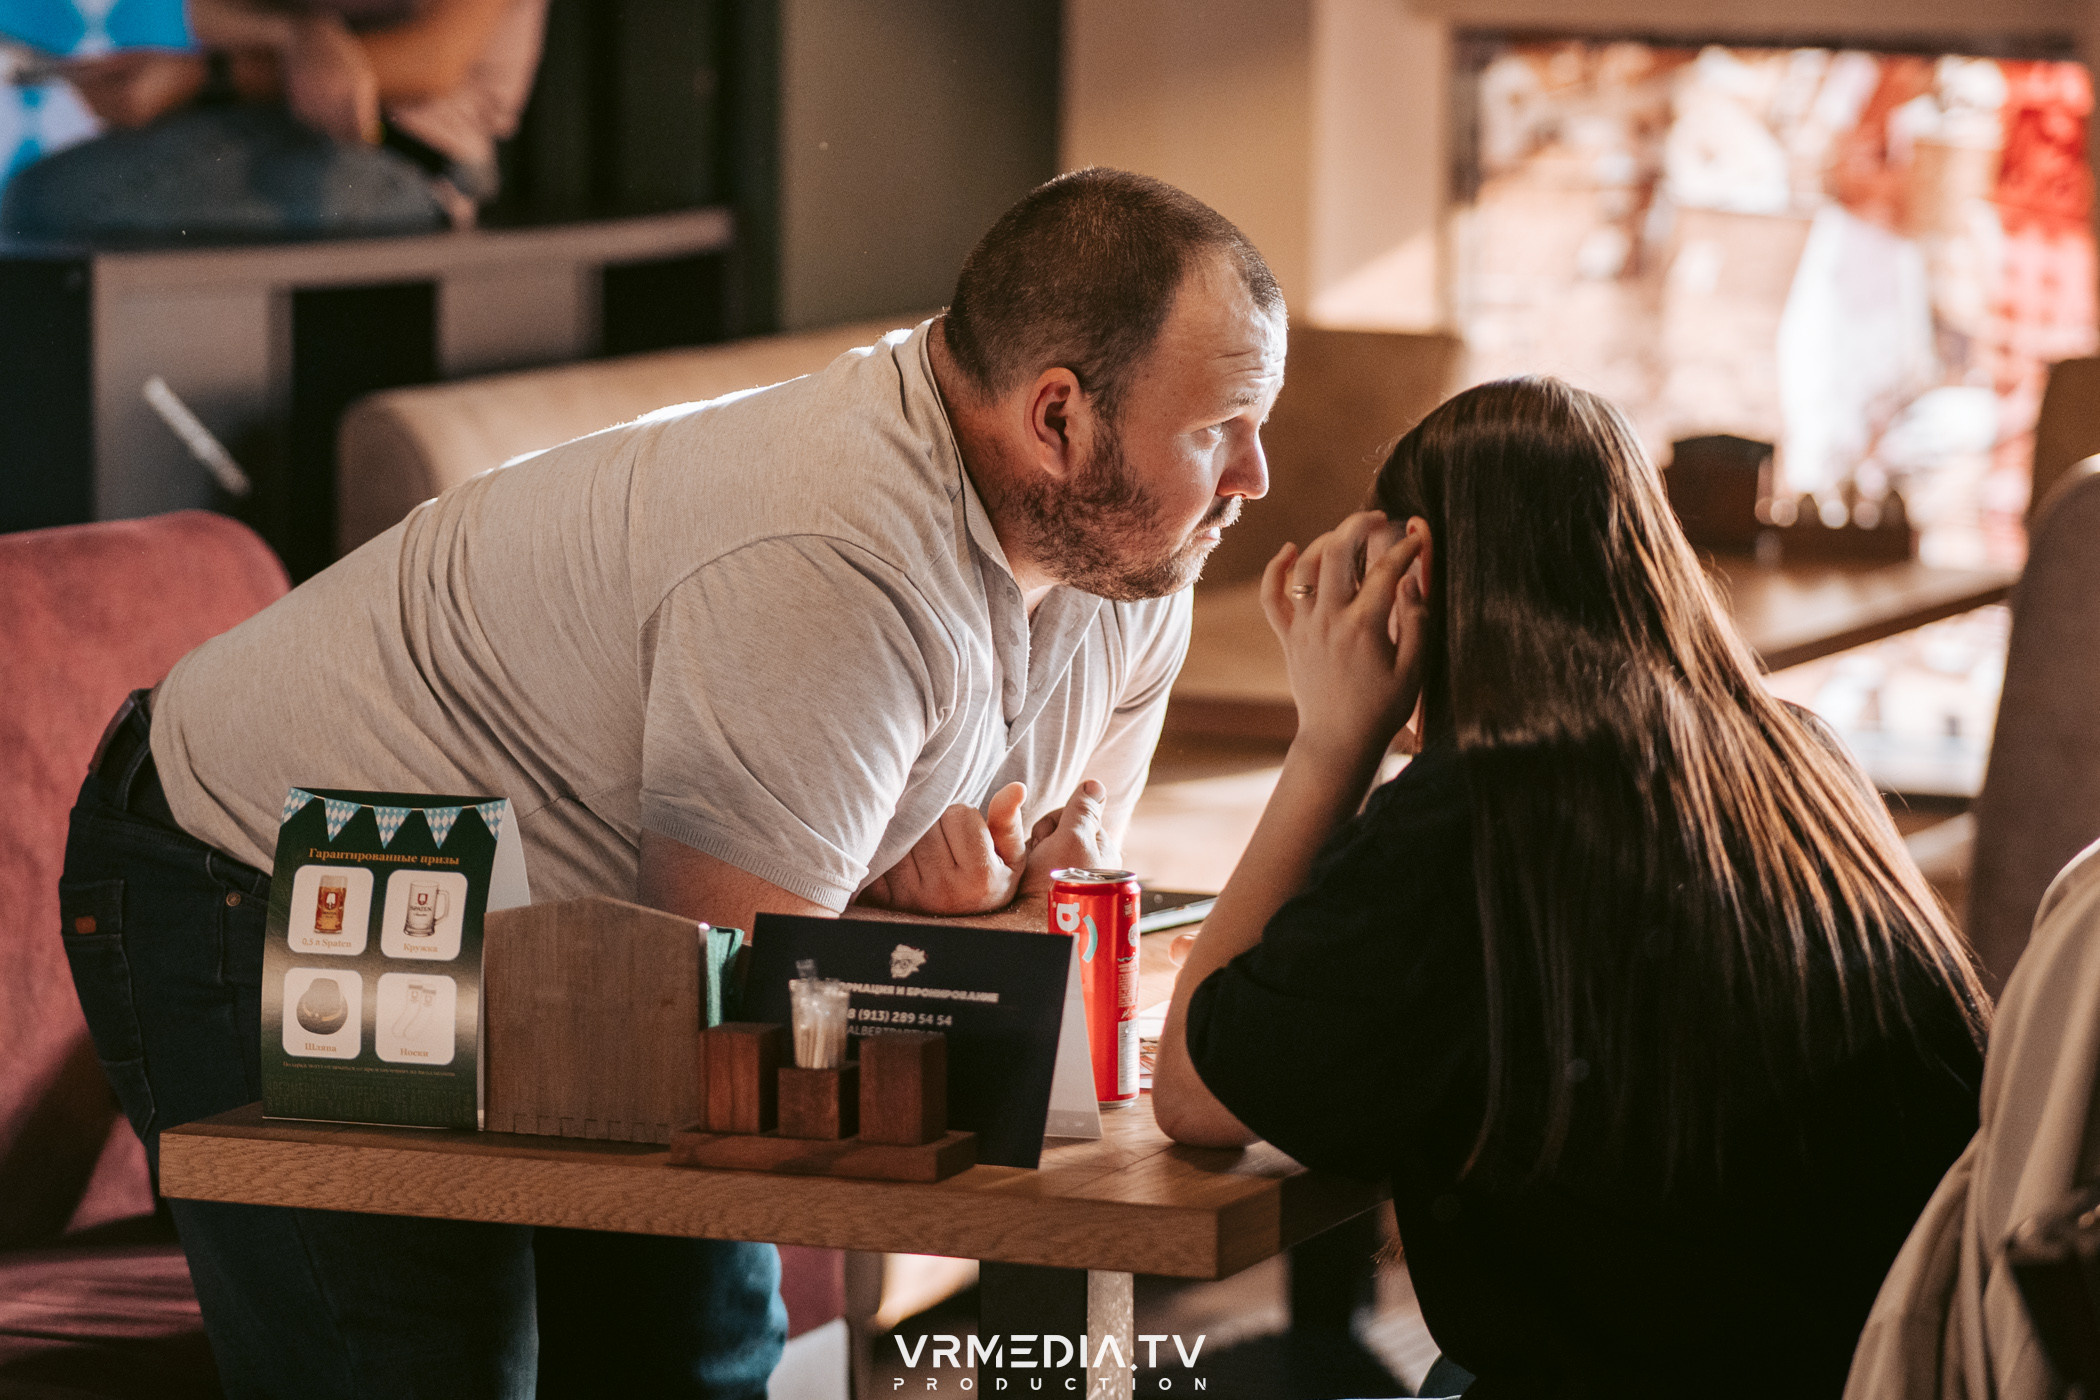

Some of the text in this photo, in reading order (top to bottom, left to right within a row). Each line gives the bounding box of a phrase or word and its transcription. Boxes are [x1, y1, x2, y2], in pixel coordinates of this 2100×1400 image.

[308, 848, 460, 866] Гарантированные призы
[322, 938, 352, 948] Spaten
[403, 943, 438, 953] Кружка
[896, 986, 905, 996] И
[906, 986, 999, 1003] БРОНИРОВАНИЕ
[847, 1008, 953, 1026] 8 (913) 289 54 54
[305, 1043, 337, 1053] Шляпа
[400, 1048, 429, 1057] Носки
